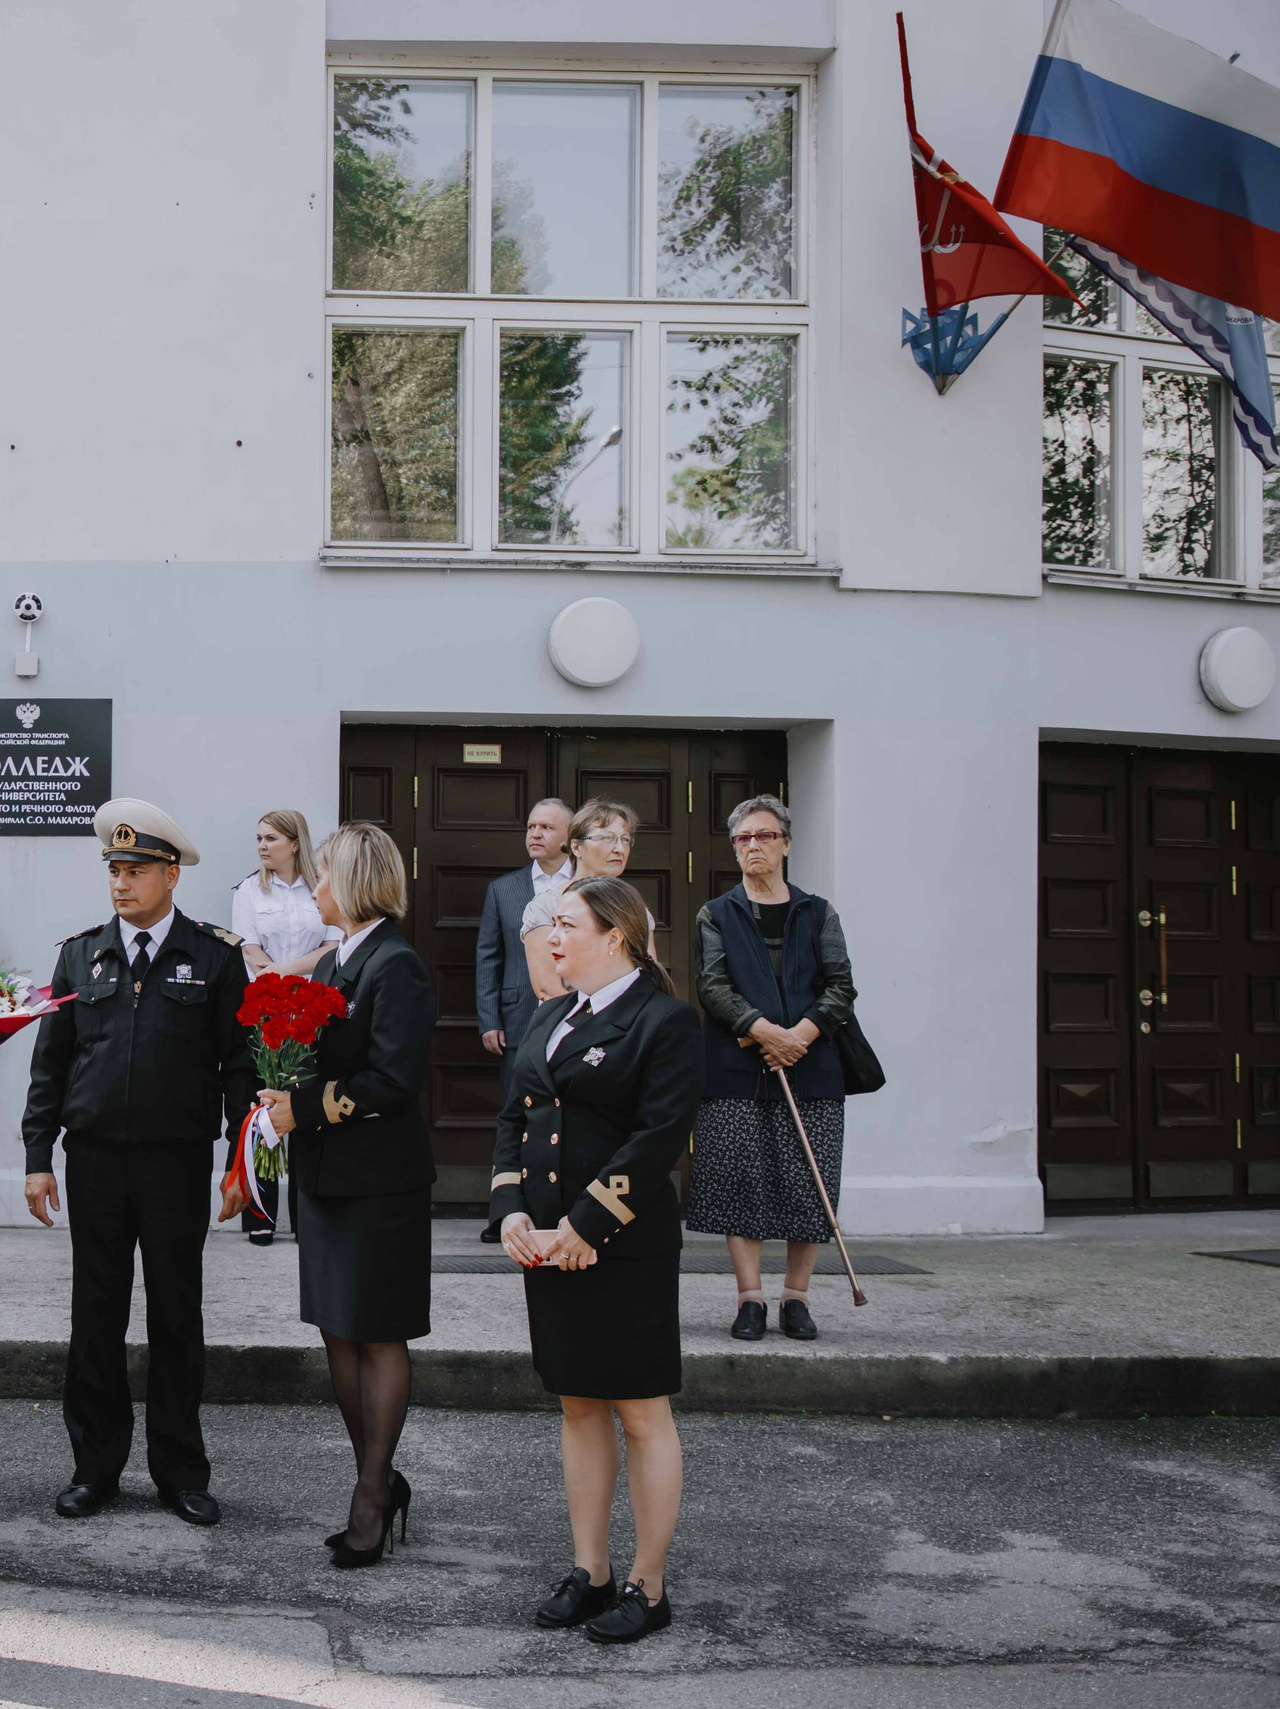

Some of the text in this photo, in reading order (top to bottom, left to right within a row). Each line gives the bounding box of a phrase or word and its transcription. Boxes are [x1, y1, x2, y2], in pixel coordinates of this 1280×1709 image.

[12, 804, 19, 813] И
[21, 804, 63, 813] РЕЧНОГО
[65, 804, 96, 813] ФЛОТА
[26, 816, 46, 825] С.О.
[47, 816, 95, 825] МАКАРОВА
